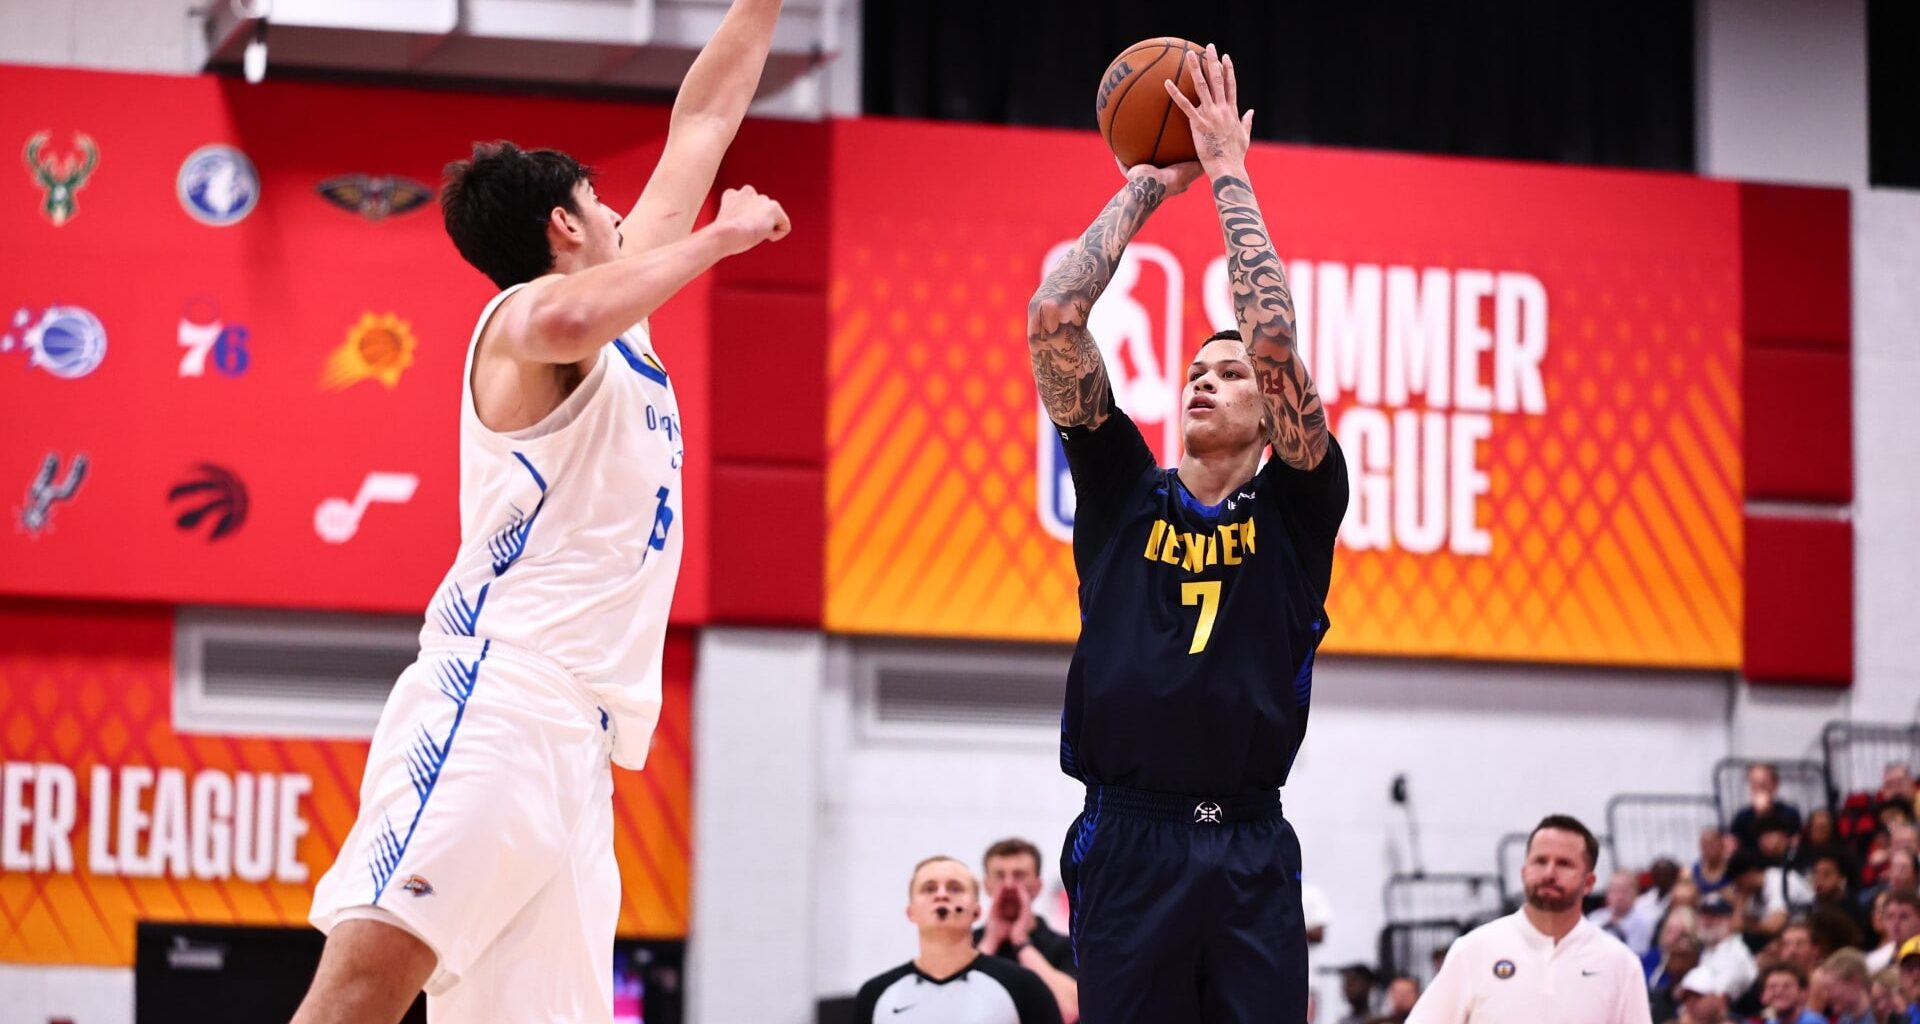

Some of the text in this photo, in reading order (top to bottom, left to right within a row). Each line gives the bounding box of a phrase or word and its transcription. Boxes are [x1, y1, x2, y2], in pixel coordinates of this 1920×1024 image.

[177, 317, 252, 379] 76
[1334, 405, 1495, 558] GUE
[1181, 580, 1222, 655] 7
[0, 761, 313, 883] ER LEAGUE
